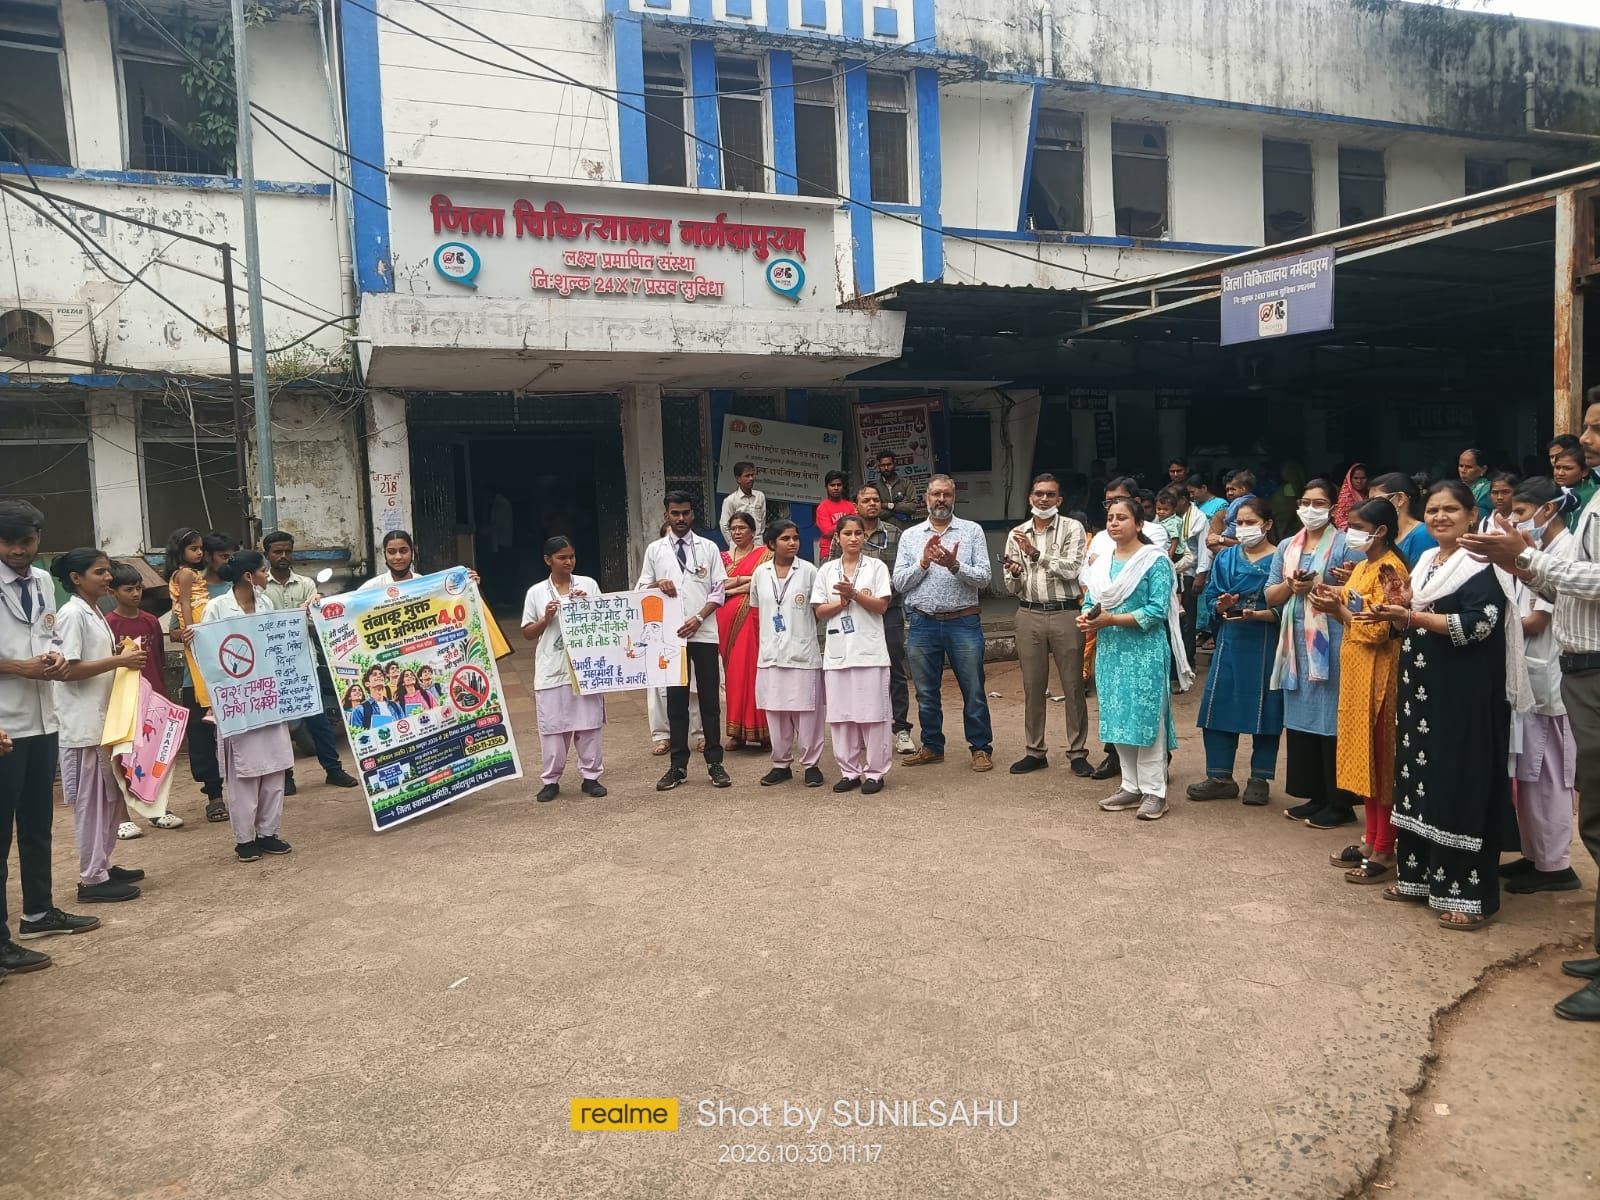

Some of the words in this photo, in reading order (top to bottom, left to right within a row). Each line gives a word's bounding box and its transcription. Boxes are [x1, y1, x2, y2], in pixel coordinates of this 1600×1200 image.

[430, 194, 505, 236] जिला
[513, 199, 672, 244] चिकित्सालय
[563, 249, 598, 268] लक्ष्य
[601, 248, 655, 270] प्रमाणित
[657, 251, 696, 272] संस्था
[1223, 276, 1242, 293] जिला
[1243, 266, 1288, 288] चिकित्सालय
[594, 277, 615, 293] 24
[632, 278, 642, 293] 7
[645, 278, 677, 296] प्रसव
[681, 276, 725, 301] सुविधा
[380, 482, 397, 494] 218
[387, 497, 396, 507] 6
[579, 598, 592, 611] को
[362, 607, 402, 632] तंबाकू
[403, 599, 431, 620] मुक्त
[565, 610, 589, 624] जीवन
[590, 609, 606, 622] को
[364, 627, 392, 650] युवा
[391, 614, 438, 640] अभियान
[438, 604, 466, 626] 4.0
[415, 631, 428, 642] Youth
[428, 626, 454, 640] Campaign
[586, 635, 594, 648] ही
[583, 665, 613, 678] महामारी
[617, 664, 623, 677] है
[168, 708, 185, 721] NO
[466, 736, 503, 753] 1800-11-2356
[396, 803, 411, 817] जिला
